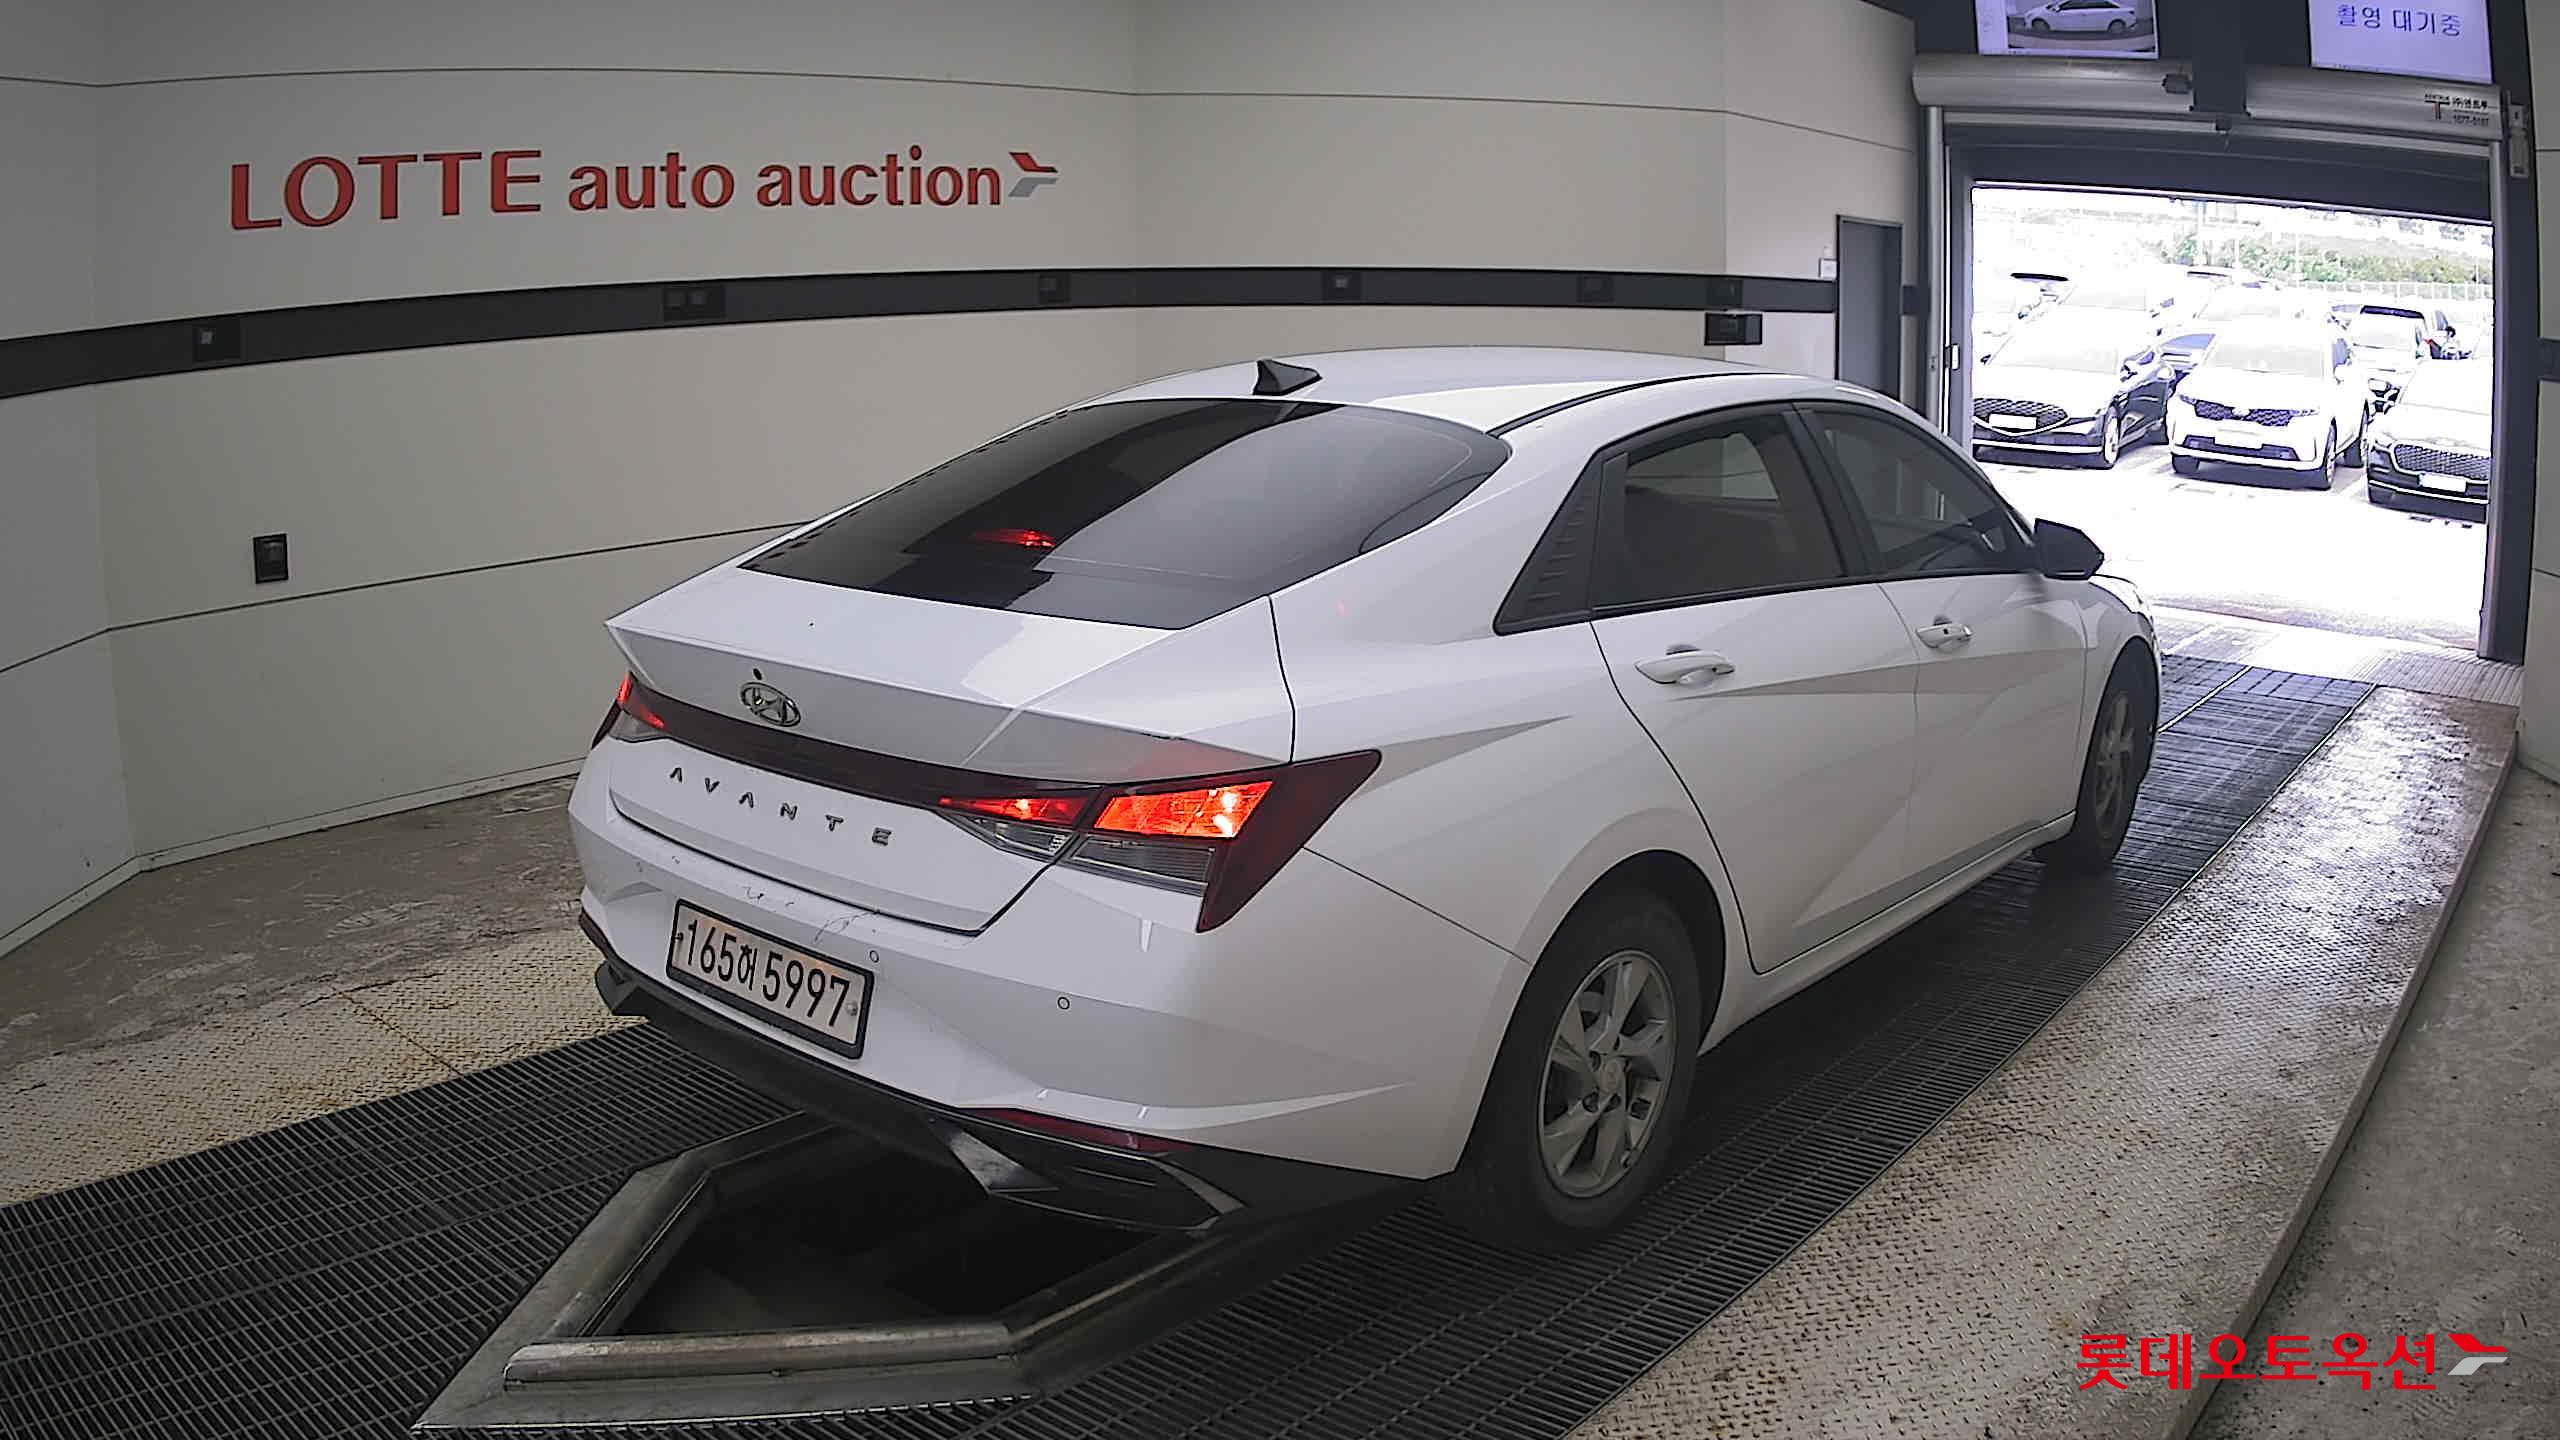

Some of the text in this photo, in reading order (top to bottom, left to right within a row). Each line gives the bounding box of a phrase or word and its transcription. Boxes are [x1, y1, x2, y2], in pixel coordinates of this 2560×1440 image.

[2337, 4, 2461, 37] 촬영 대기중
[231, 146, 1002, 230] LOTTE auto auction
[669, 767, 892, 846] AVANTE
[687, 919, 851, 1027] 165허5997
